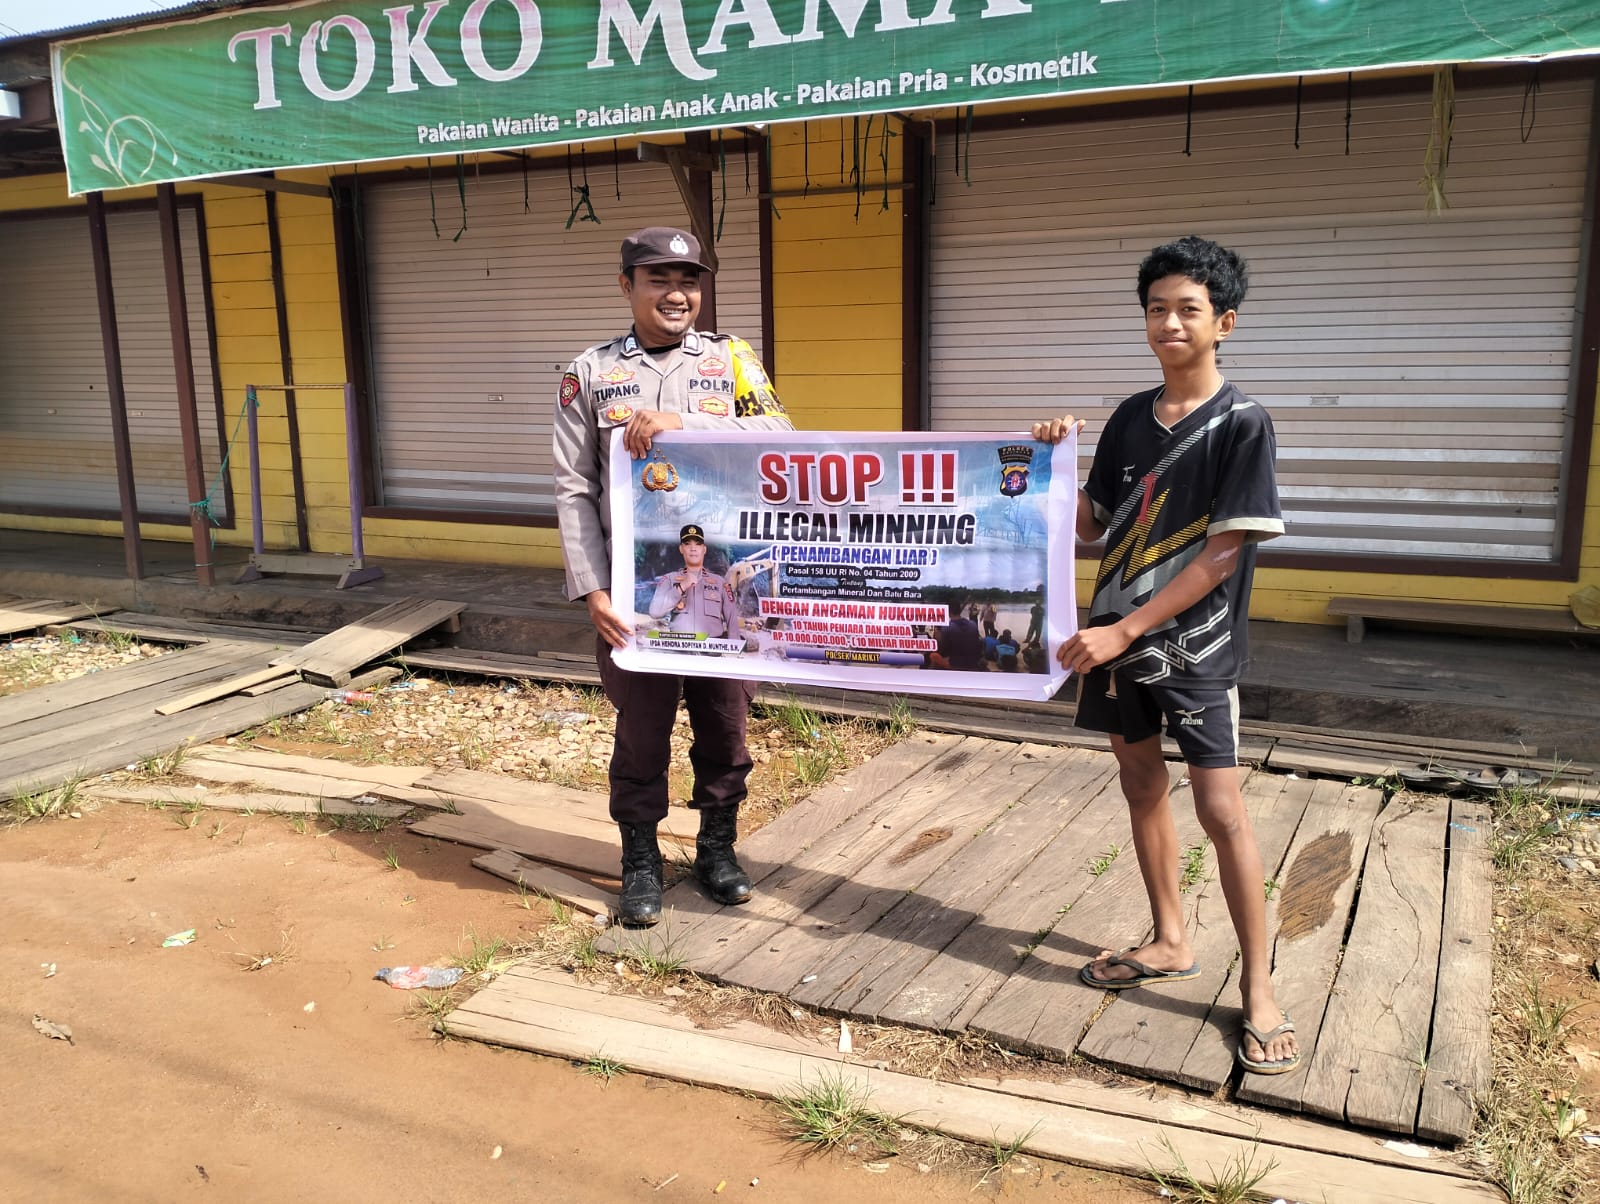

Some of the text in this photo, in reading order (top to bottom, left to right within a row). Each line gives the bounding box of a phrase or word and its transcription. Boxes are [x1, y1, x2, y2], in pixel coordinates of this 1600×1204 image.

[228, 0, 1032, 110] TOKO MA
[418, 120, 488, 144] Pakaian
[492, 113, 559, 136] Wanita
[576, 103, 655, 128] Pakaian
[660, 94, 717, 119] Anak
[720, 87, 779, 113] Anak
[796, 77, 891, 105] Pakaian
[899, 68, 948, 94] Pria
[971, 51, 1098, 86] Kosmetik
[594, 384, 641, 402] TUPANG
[689, 379, 734, 393] POLRI
[760, 452, 956, 505] STOP !!!
[739, 511, 976, 545] ILLEGAL MINNING
[781, 546, 892, 564] PENAMBANGAN
[895, 551, 928, 566] LIAR
[788, 566, 918, 578] Pasal 158 UU RI No. 04 Tahun 2009
[782, 586, 922, 599] Pertambangan Mineral Dan Batu Bara
[761, 600, 946, 622] DENGAN ANCAMAN HUKUMAN
[792, 620, 912, 636] 10 TAHUN PENJARA DAN DENDA
[772, 631, 784, 641] RP.
[867, 638, 897, 648] MILYAR
[899, 639, 930, 650] RUPIAH
[825, 650, 880, 662] POLSEK MARIKIT
